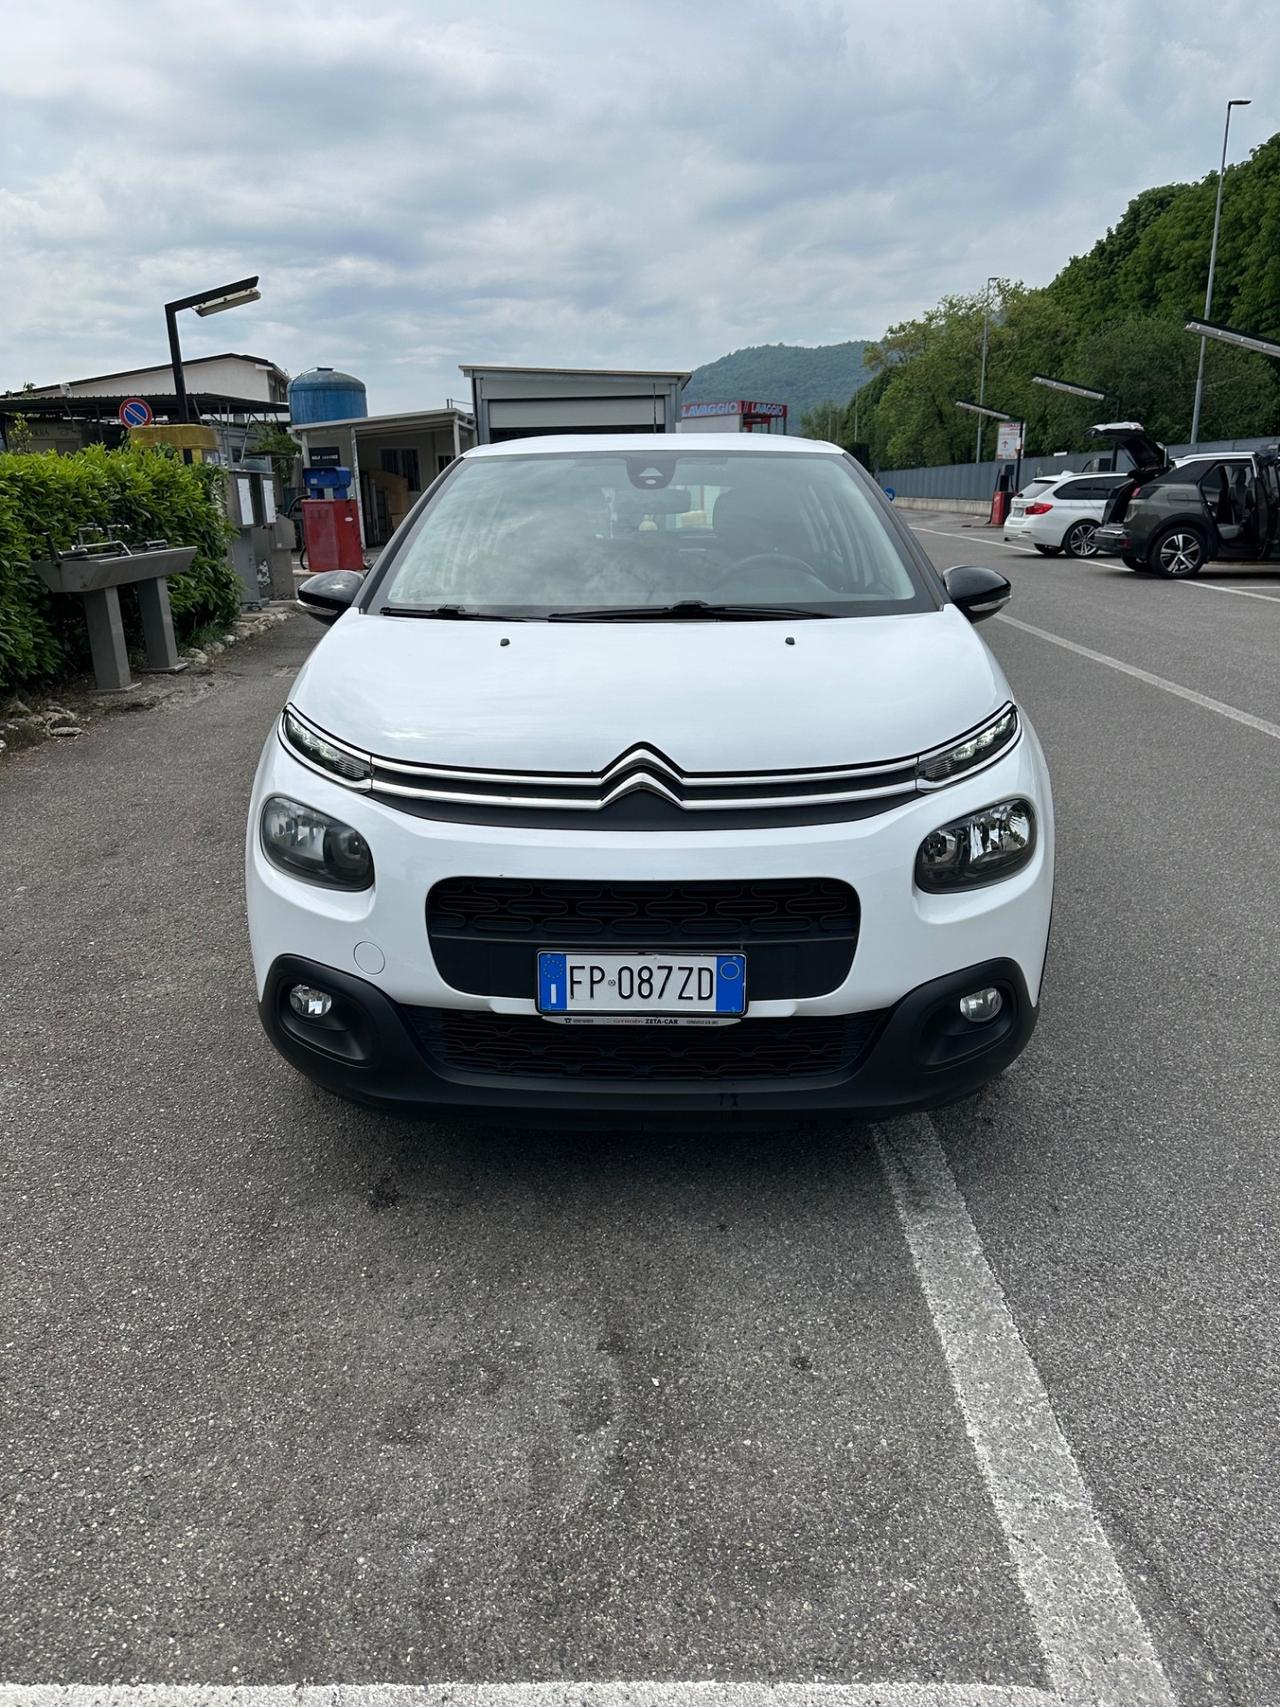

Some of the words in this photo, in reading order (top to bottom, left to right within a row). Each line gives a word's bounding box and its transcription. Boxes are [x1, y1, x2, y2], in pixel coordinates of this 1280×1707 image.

[681, 402, 738, 417] LAVAGGIO
[751, 403, 784, 416] LAVAGGIO
[569, 965, 606, 1000] FP
[617, 965, 714, 1001] 087ZD
